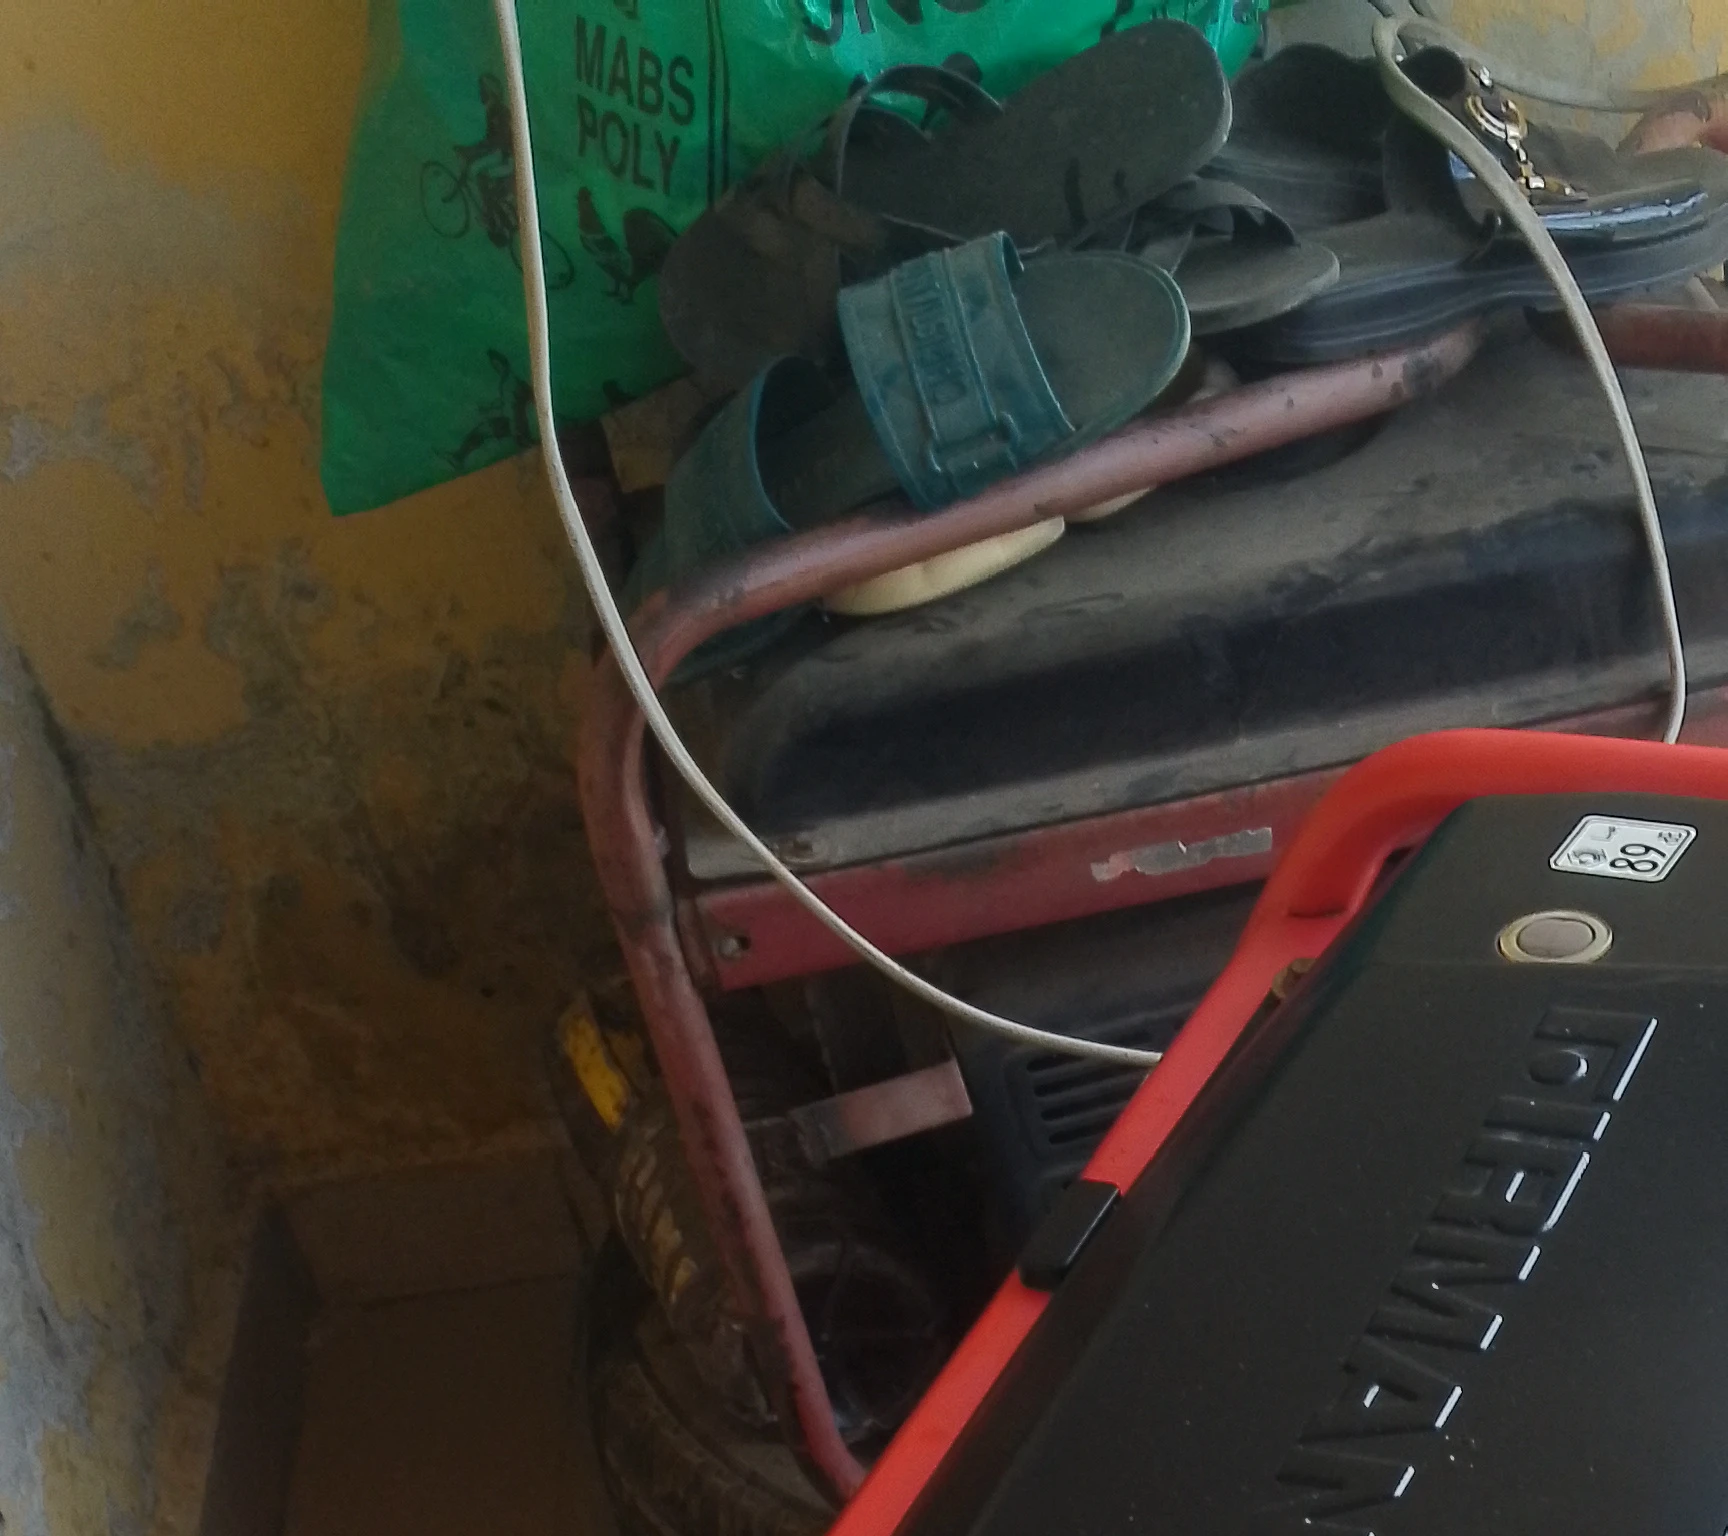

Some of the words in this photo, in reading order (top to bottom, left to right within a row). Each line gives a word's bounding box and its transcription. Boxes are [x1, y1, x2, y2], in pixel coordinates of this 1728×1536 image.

[574, 15, 696, 126] MABS
[577, 94, 680, 195] POLY
[1609, 843, 1667, 872] 89
